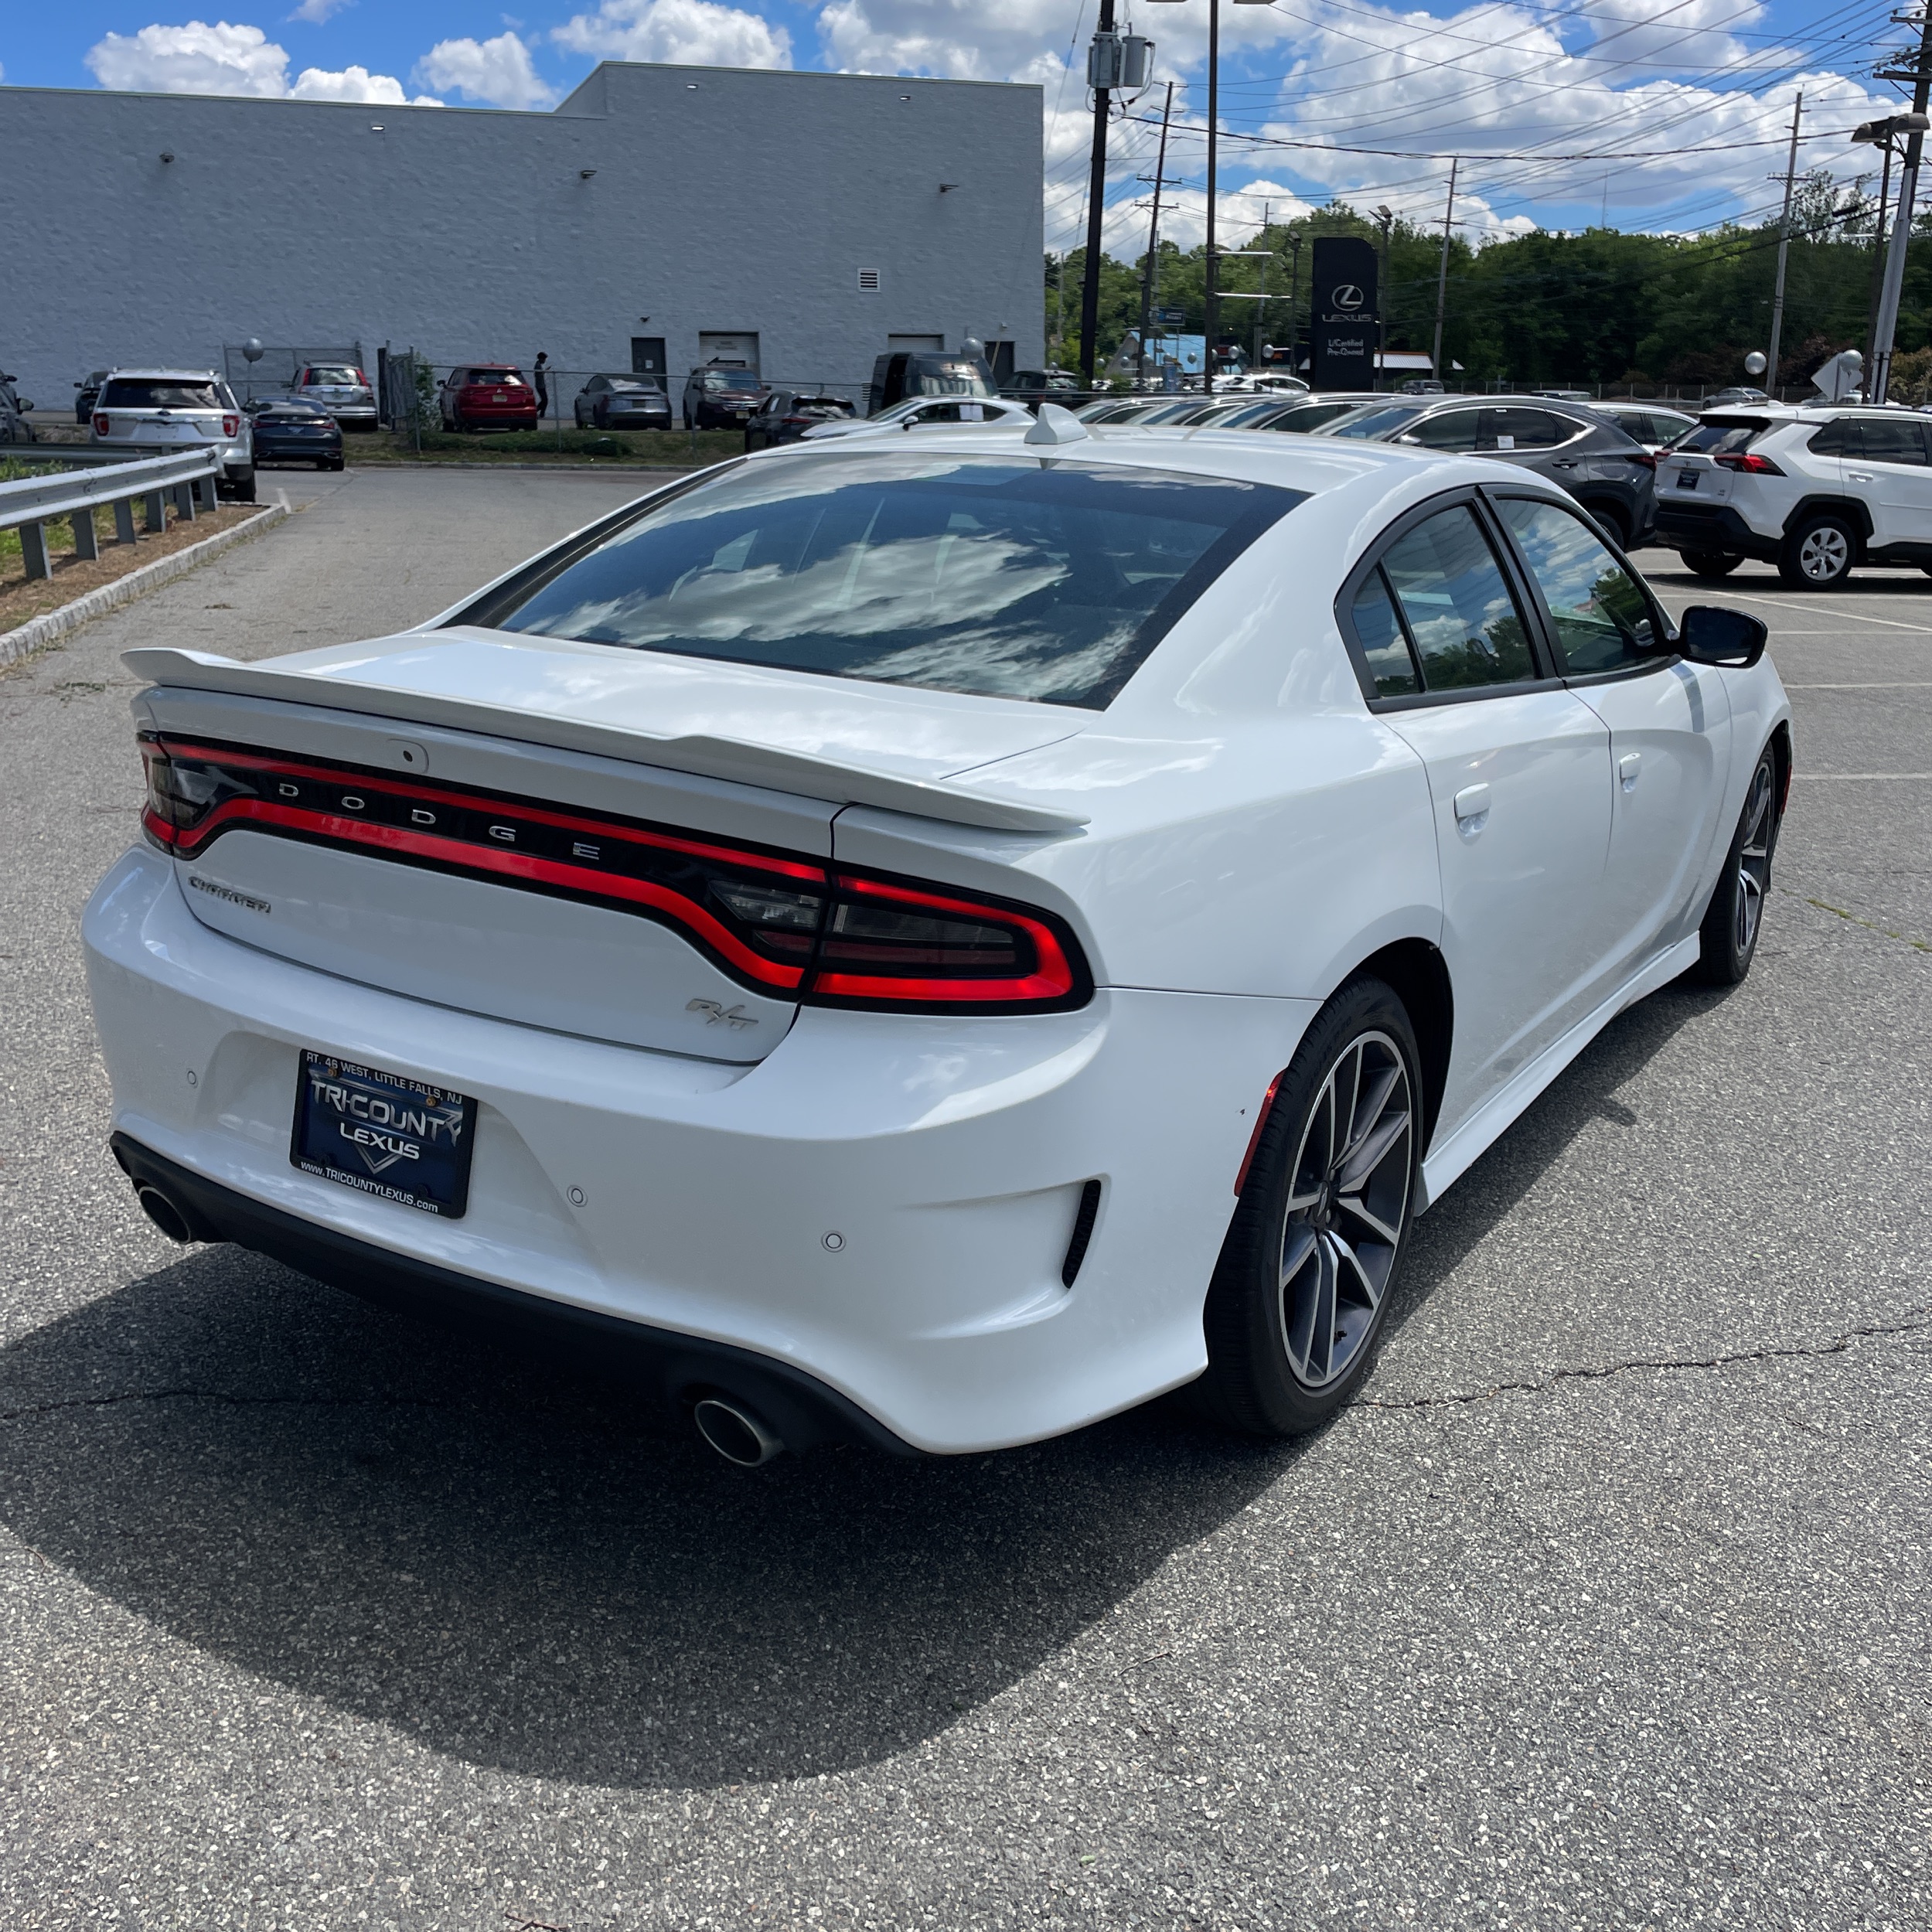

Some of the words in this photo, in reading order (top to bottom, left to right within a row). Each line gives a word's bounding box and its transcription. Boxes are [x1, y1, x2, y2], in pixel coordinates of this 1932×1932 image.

[1321, 314, 1372, 322] LEXUS
[1327, 347, 1365, 356] Pre-Owned
[279, 782, 601, 860] DODGE
[685, 998, 759, 1031] R/T
[306, 1051, 322, 1065] RT.
[325, 1057, 339, 1069] 46
[340, 1061, 372, 1081] WEST,
[374, 1072, 407, 1089] LITTLE
[409, 1081, 444, 1102] FALLS,
[447, 1092, 462, 1105] NJ
[340, 1122, 420, 1160] LEXUS
[301, 1161, 438, 1213] www.TRICOUNTYLEXUS.com
